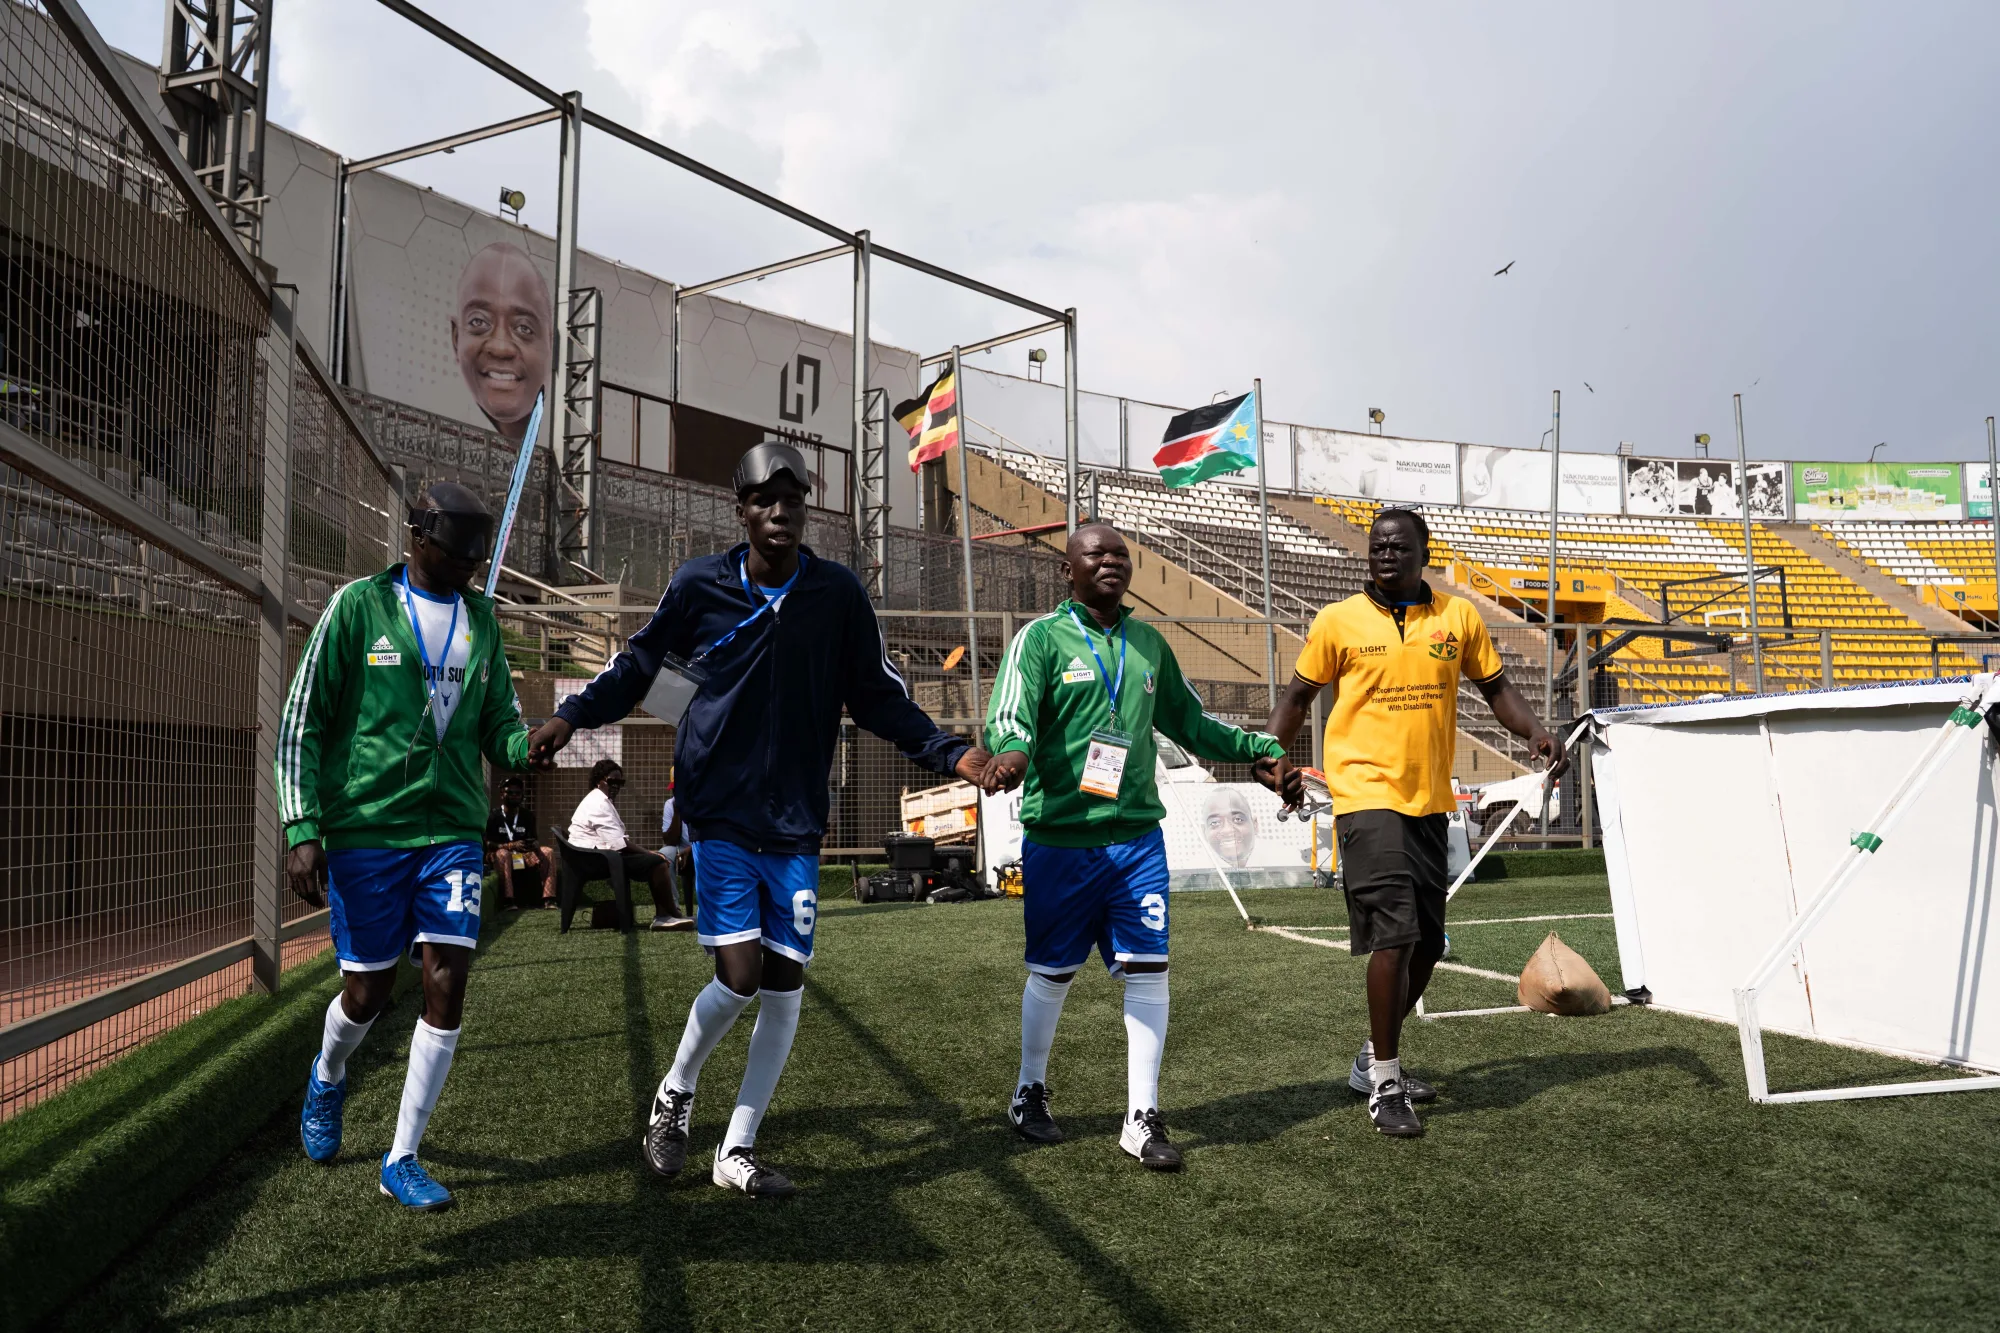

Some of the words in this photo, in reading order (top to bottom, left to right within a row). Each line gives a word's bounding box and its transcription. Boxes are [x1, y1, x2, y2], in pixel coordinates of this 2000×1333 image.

[1396, 460, 1433, 468] NAKIVUBO
[1359, 645, 1387, 654] LIGHT
[1406, 682, 1439, 692] Celebration
[1371, 694, 1407, 704] International
[1407, 693, 1419, 702] Day
[1387, 704, 1402, 712] With
[443, 869, 481, 917] 13
[792, 889, 817, 935] 6
[1140, 893, 1166, 931] 3
